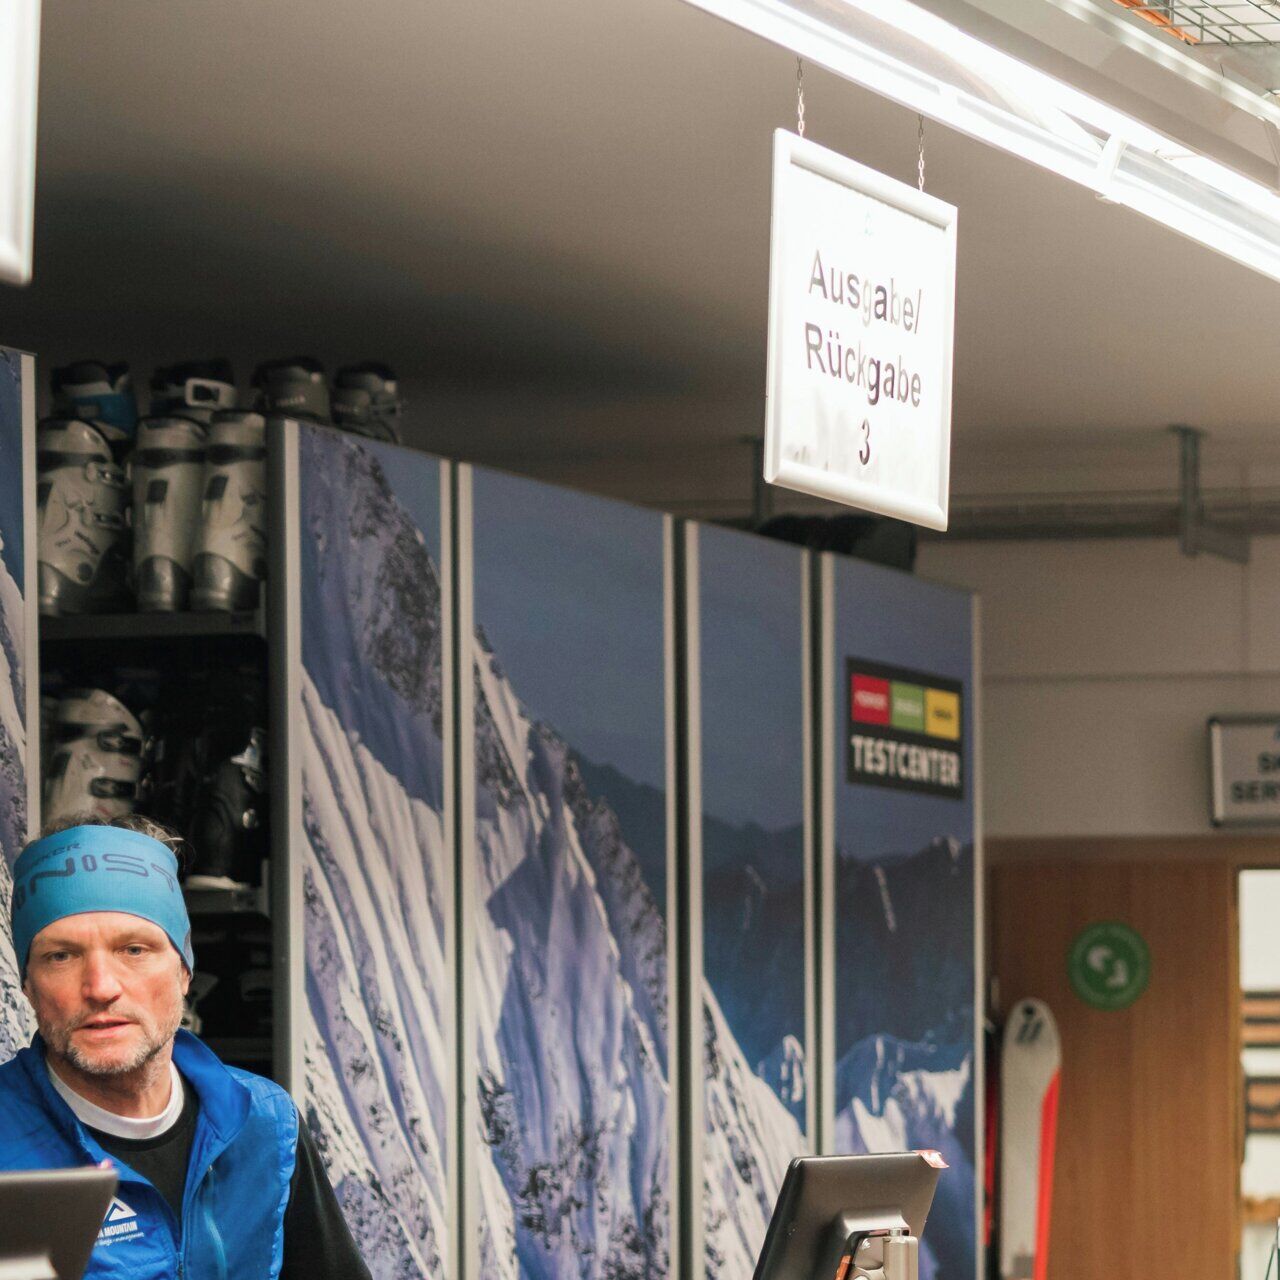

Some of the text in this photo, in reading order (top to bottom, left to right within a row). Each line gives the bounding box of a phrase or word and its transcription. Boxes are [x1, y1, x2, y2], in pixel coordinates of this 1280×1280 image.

[808, 249, 922, 335] Ausgabe/
[804, 321, 922, 408] Rückgabe
[858, 417, 871, 466] 3
[851, 734, 960, 787] TESTCENTER
[104, 1220, 138, 1237] MOUNTAIN
